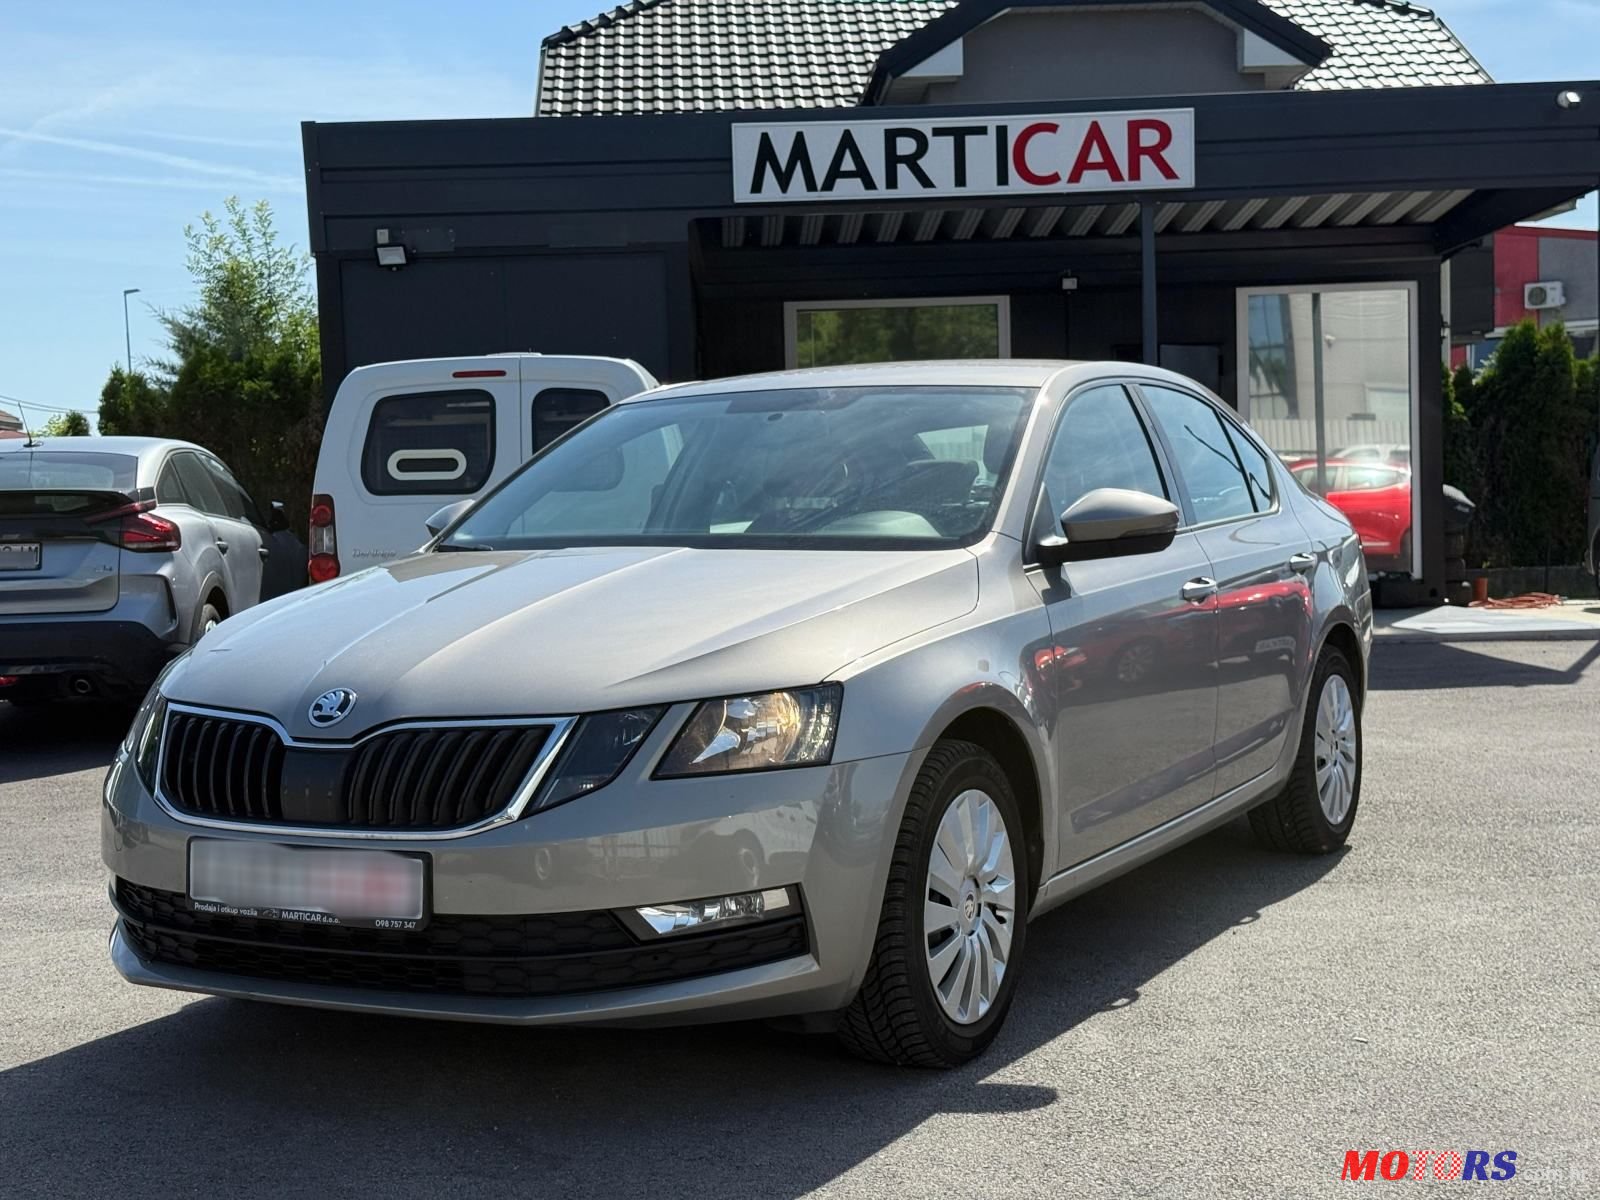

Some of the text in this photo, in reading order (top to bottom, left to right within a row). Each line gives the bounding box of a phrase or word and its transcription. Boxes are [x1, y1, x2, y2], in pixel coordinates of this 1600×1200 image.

[750, 119, 1180, 194] MARTICAR
[194, 901, 217, 913] Prodaja
[221, 904, 239, 916] otkup
[239, 907, 258, 917] vozila
[281, 910, 322, 922] MARTICAR
[322, 913, 341, 924] d.o.o.
[375, 919, 389, 928] 098
[390, 920, 402, 929] 757
[404, 921, 416, 929] 347
